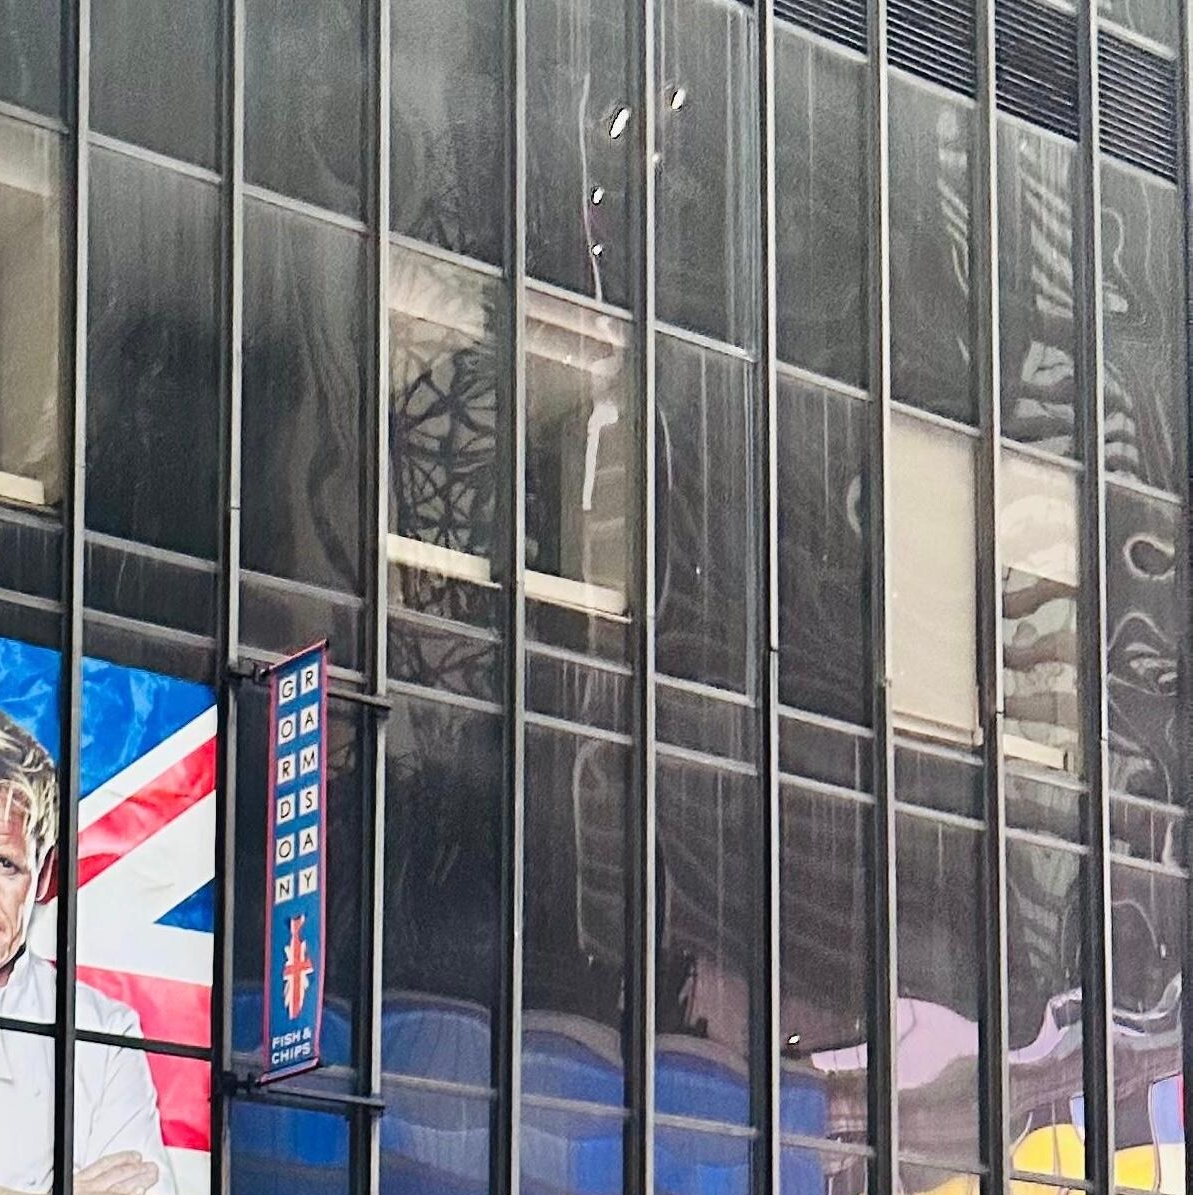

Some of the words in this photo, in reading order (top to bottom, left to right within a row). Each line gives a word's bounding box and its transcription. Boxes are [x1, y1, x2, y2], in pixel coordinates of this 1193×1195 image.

[279, 680, 295, 898] GORDON
[302, 670, 316, 890] RAMSAY
[271, 1029, 301, 1050] FISH
[271, 1042, 311, 1064] CHIPS
